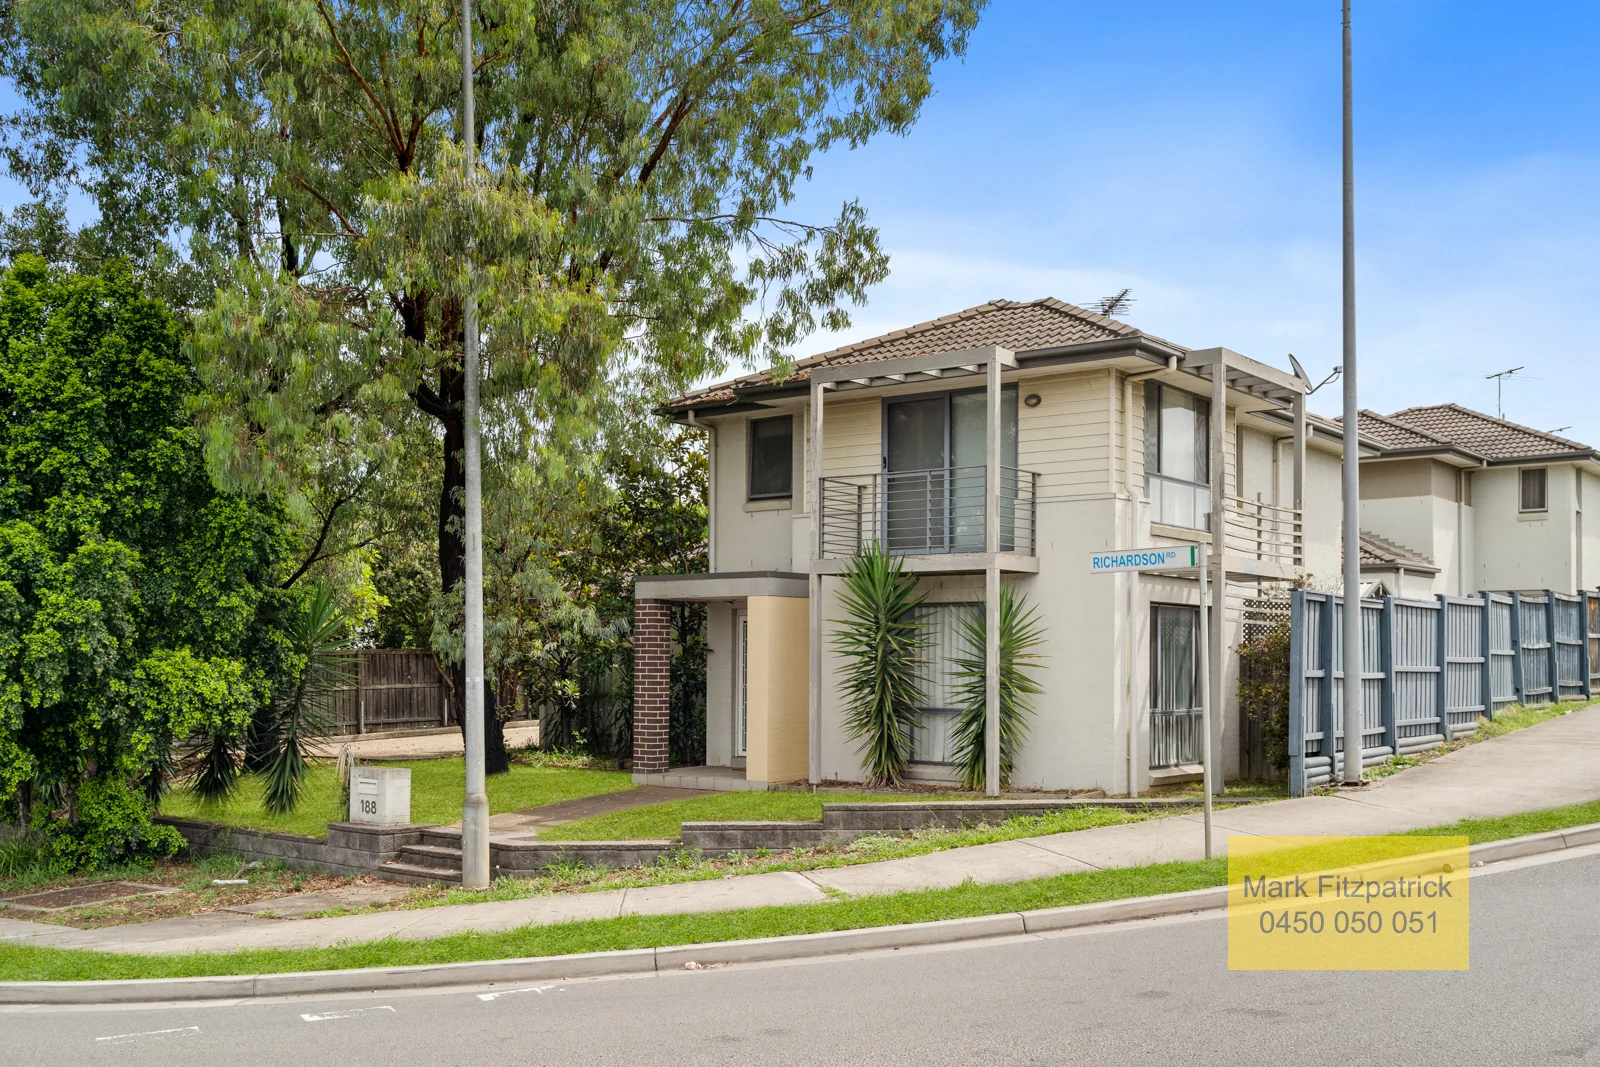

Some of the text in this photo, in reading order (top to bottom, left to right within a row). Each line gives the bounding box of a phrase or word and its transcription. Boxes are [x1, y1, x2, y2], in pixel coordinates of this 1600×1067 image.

[1093, 551, 1176, 569] RICHARDSON RD
[360, 799, 377, 815] 188
